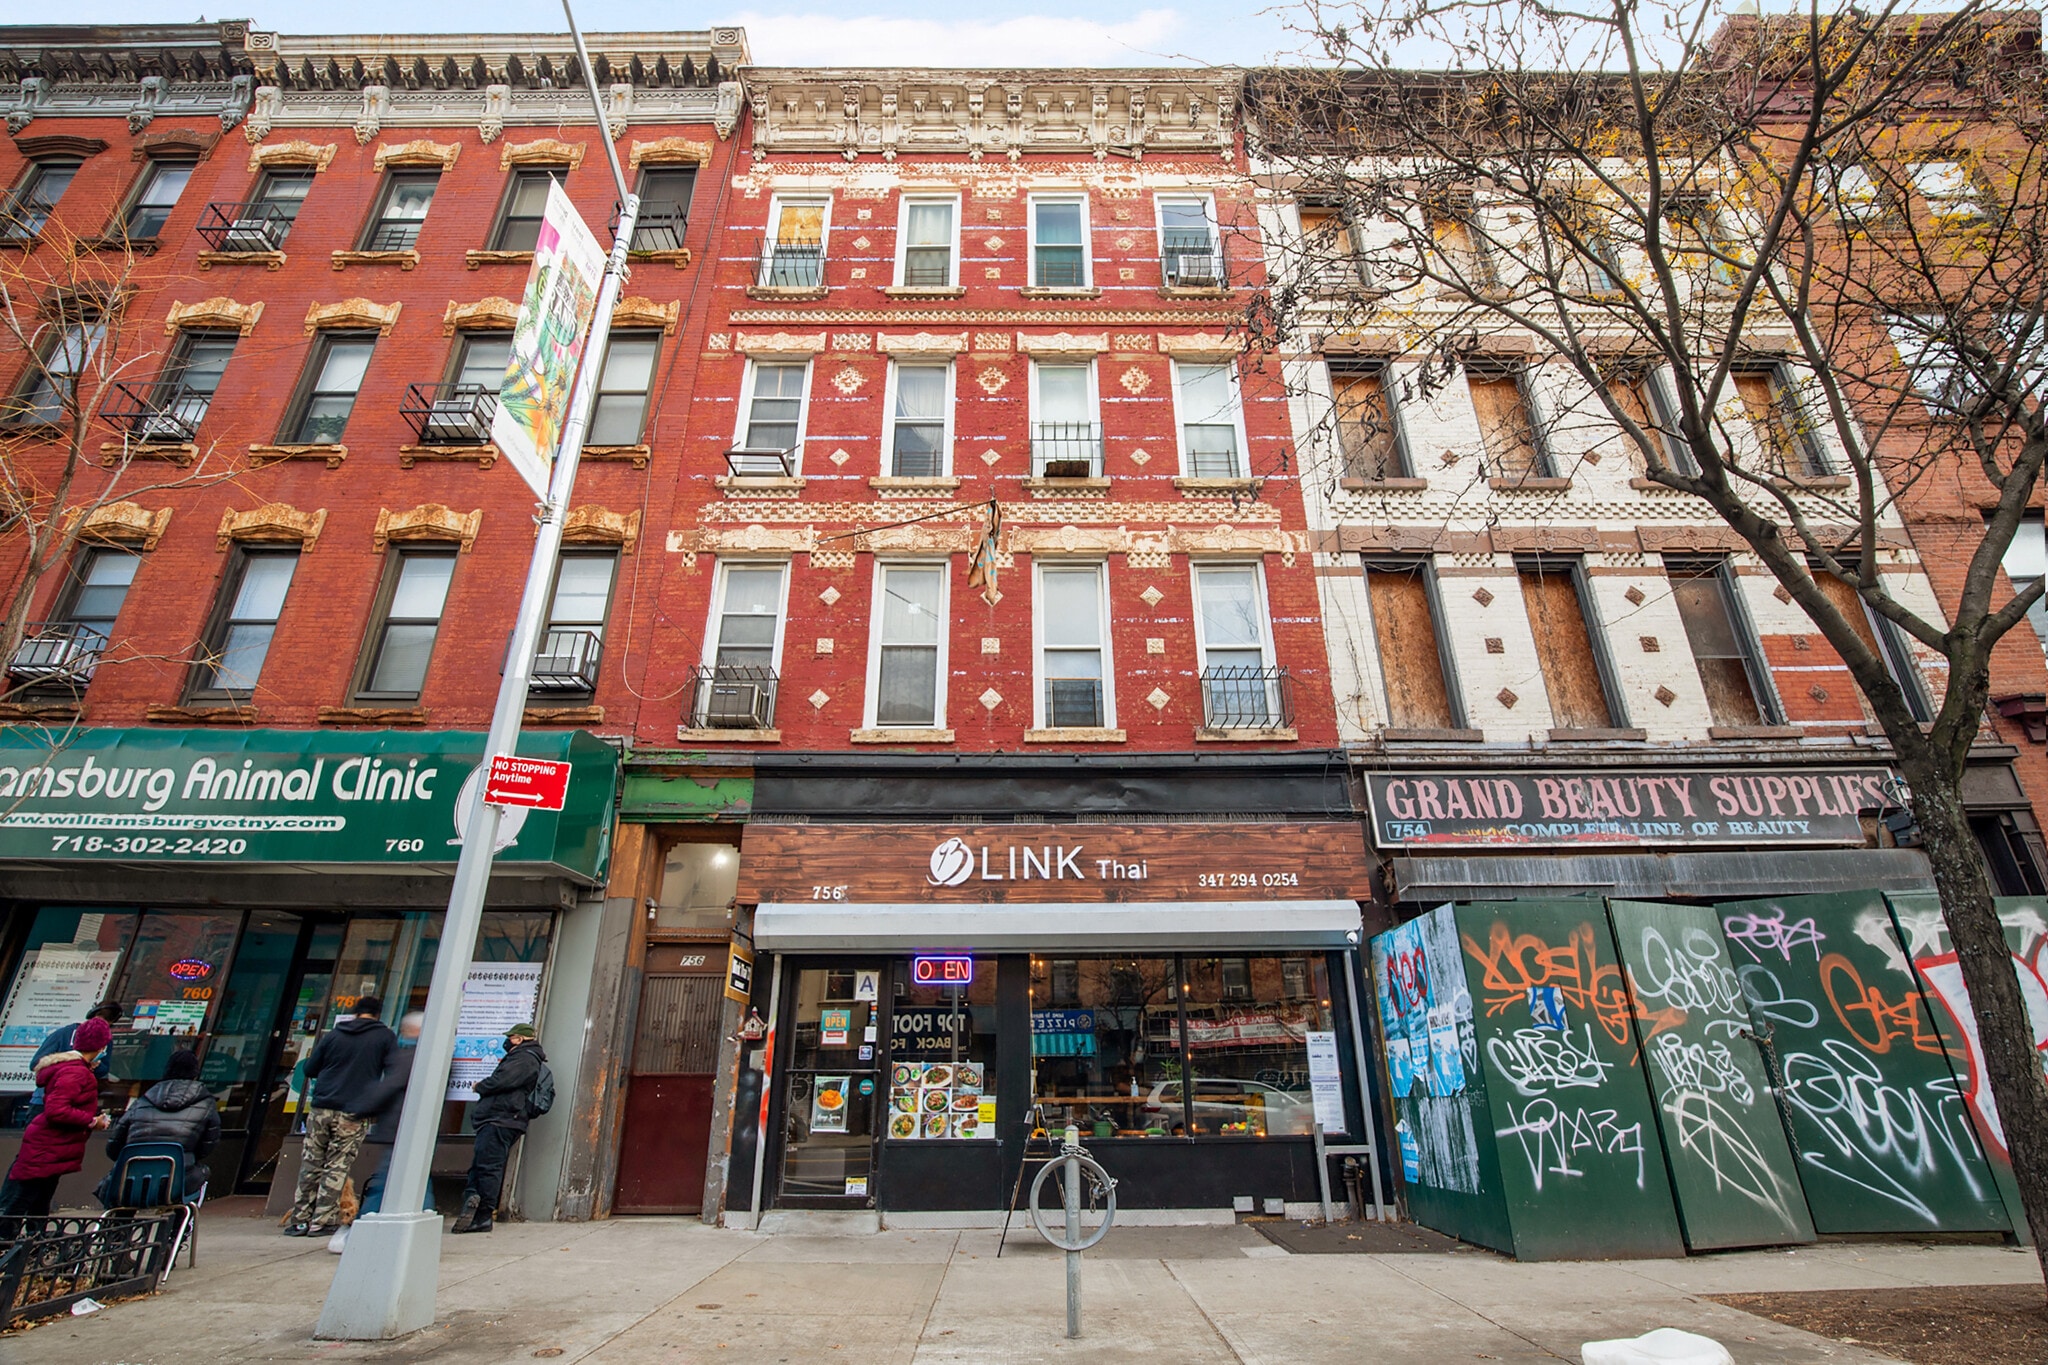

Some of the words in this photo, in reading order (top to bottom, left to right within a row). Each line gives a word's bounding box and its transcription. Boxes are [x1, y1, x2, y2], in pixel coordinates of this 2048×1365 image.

[495, 760, 509, 770] NO
[511, 762, 556, 776] STOPPING
[182, 757, 325, 801] Animal
[332, 756, 438, 801] Clinic
[493, 771, 532, 784] Anytime
[1386, 778, 1524, 820] GRAND
[1533, 775, 1695, 820] BEAUTY
[1709, 774, 1891, 818] SUPPLIES
[1391, 823, 1427, 837] 754
[1631, 822, 1685, 837] LINE
[1692, 822, 1721, 837] OF
[1730, 821, 1810, 836] BEAUTY
[51, 834, 248, 855] 718-302-2420
[385, 838, 425, 852] 760
[1096, 859, 1149, 880] Thai
[812, 886, 843, 900] 756
[1198, 873, 1225, 887] 347
[1229, 873, 1257, 887] 294
[682, 955, 704, 966] 756
[170, 963, 210, 977] OPEN
[917, 960, 969, 980] OPEN
[859, 975, 874, 992] A
[183, 986, 212, 999] 760
[825, 1016, 847, 1028] OPEN
